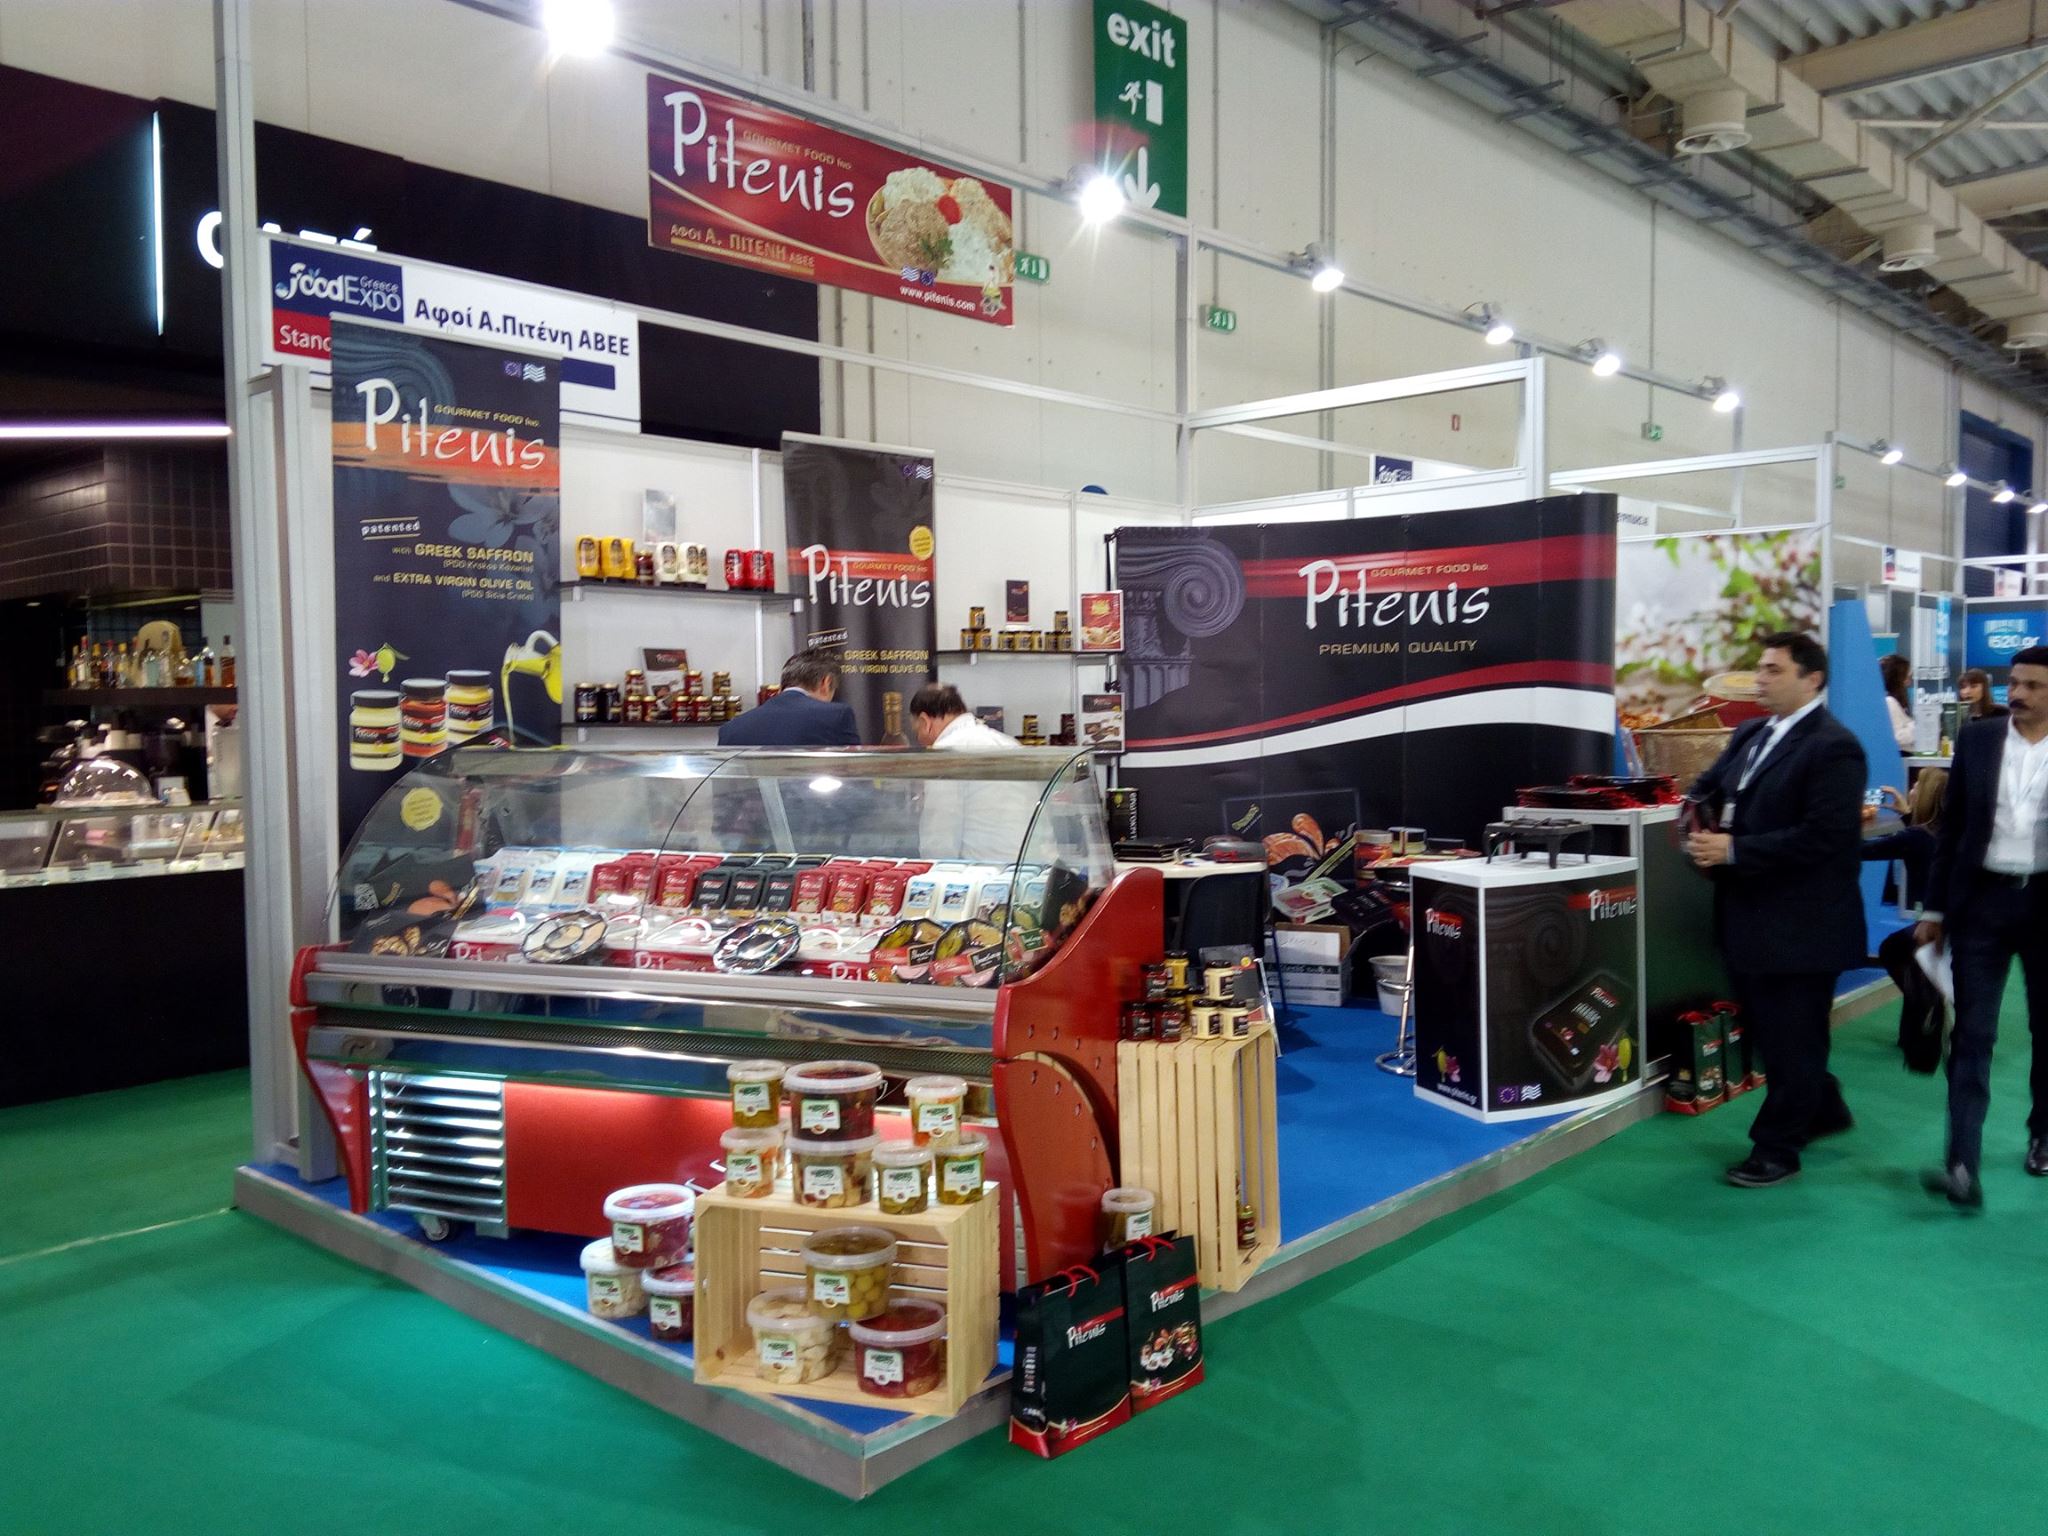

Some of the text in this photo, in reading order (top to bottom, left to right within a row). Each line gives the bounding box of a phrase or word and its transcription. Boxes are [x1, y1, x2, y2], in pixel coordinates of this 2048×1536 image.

[1107, 12, 1175, 68] exit
[664, 91, 855, 218] Pitenis
[743, 130, 800, 154] GOURMET
[804, 147, 834, 165] FOOD
[729, 234, 786, 261] ΠΙΤΕΝΗ
[360, 275, 399, 293] Greece
[899, 286, 976, 312] www.pitenis.com
[415, 298, 473, 329] Αφοί
[578, 329, 630, 357] ΑΒΕΕ
[355, 377, 546, 470] Pitenis
[433, 404, 491, 421] GOURMET
[493, 412, 523, 425] FOOD
[361, 520, 421, 537] patented
[414, 543, 463, 559] GREEK
[466, 547, 534, 563] SAFFRON
[392, 571, 432, 586] EXTRA
[435, 575, 477, 588] VIRGIN
[479, 577, 513, 590] OLIVE
[515, 579, 534, 591] OIL
[801, 544, 931, 609] Pitenis
[1370, 566, 1434, 578] GOURMET
[1436, 563, 1471, 575] FOOD
[1298, 559, 1490, 631] Pitenis
[843, 649, 929, 661] GREEK SAFFRON
[1319, 639, 1479, 655] PREMIUM QUALITY
[860, 664, 888, 674] VIRGIN
[889, 664, 914, 674] OLIVE
[915, 664, 930, 673] OIL
[1588, 888, 1638, 922] Pitenis
[1425, 907, 1462, 940] Pitenis
[1066, 1322, 1107, 1350] Pitenis
